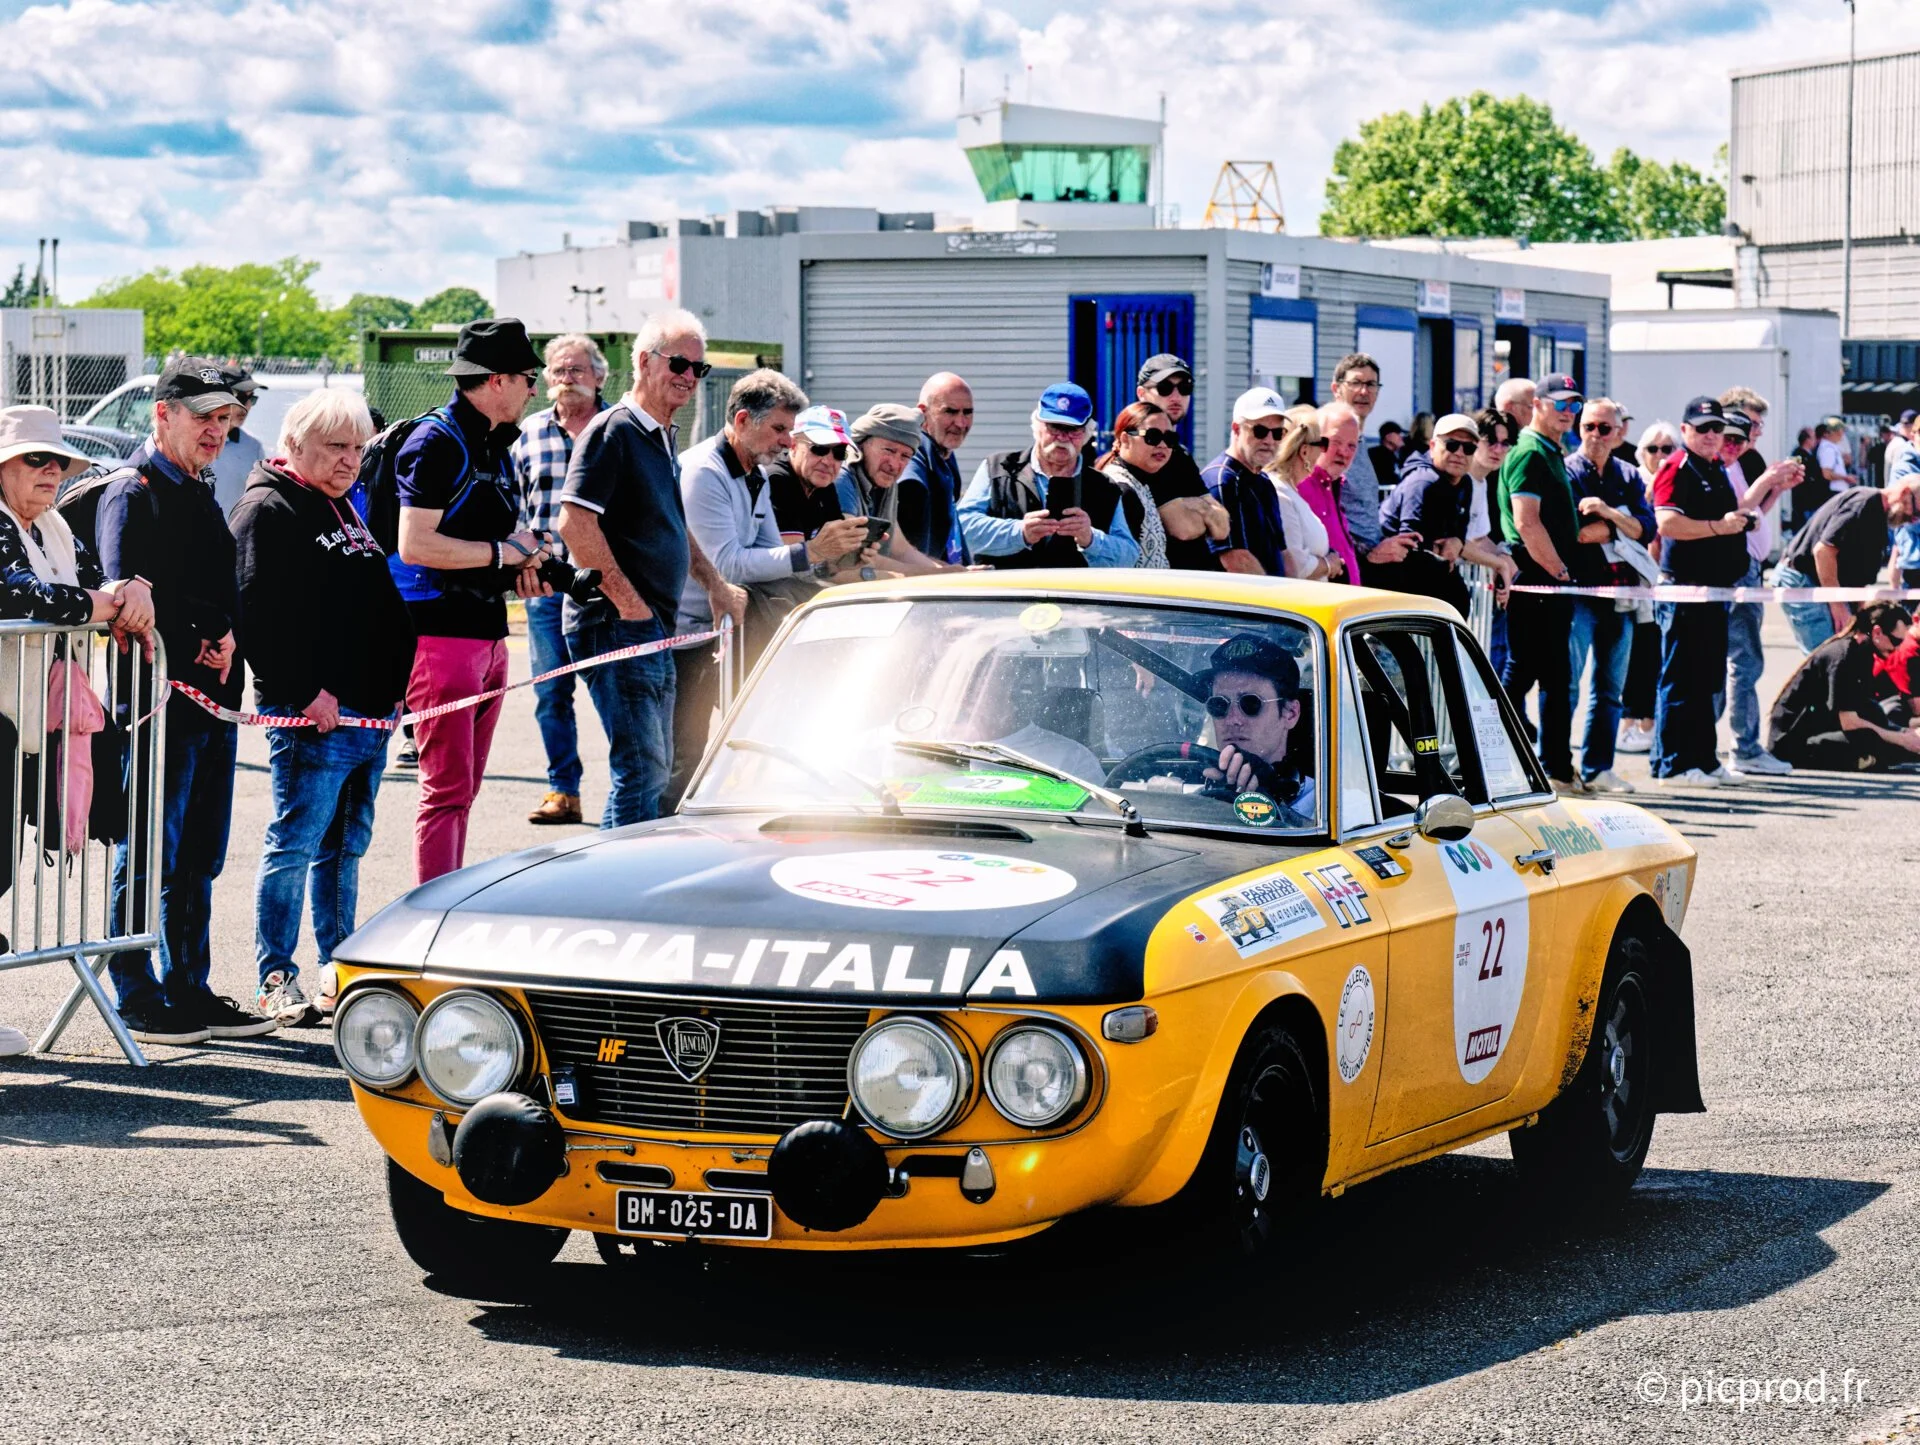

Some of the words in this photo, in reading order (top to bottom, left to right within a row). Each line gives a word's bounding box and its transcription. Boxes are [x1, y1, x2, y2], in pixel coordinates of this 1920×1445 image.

[315, 527, 347, 551] Los
[963, 777, 1002, 790] 22
[1538, 820, 1603, 858] Alitalia
[867, 867, 976, 888] 22
[1241, 876, 1294, 902] PASSION
[1302, 863, 1372, 930] HF
[388, 919, 1038, 997] LANCIA-ITALIA
[1478, 917, 1506, 981] 22
[1338, 1007, 1345, 1028] LE
[1342, 969, 1371, 1004] COLLECTIF
[597, 1038, 628, 1063] HF
[679, 1033, 707, 1054] LANCIA
[1339, 1054, 1350, 1079] DES
[1347, 1011, 1375, 1080] LUNETIERS
[1466, 1028, 1500, 1061] MOTUL
[627, 1196, 758, 1231] BM-025-DA
